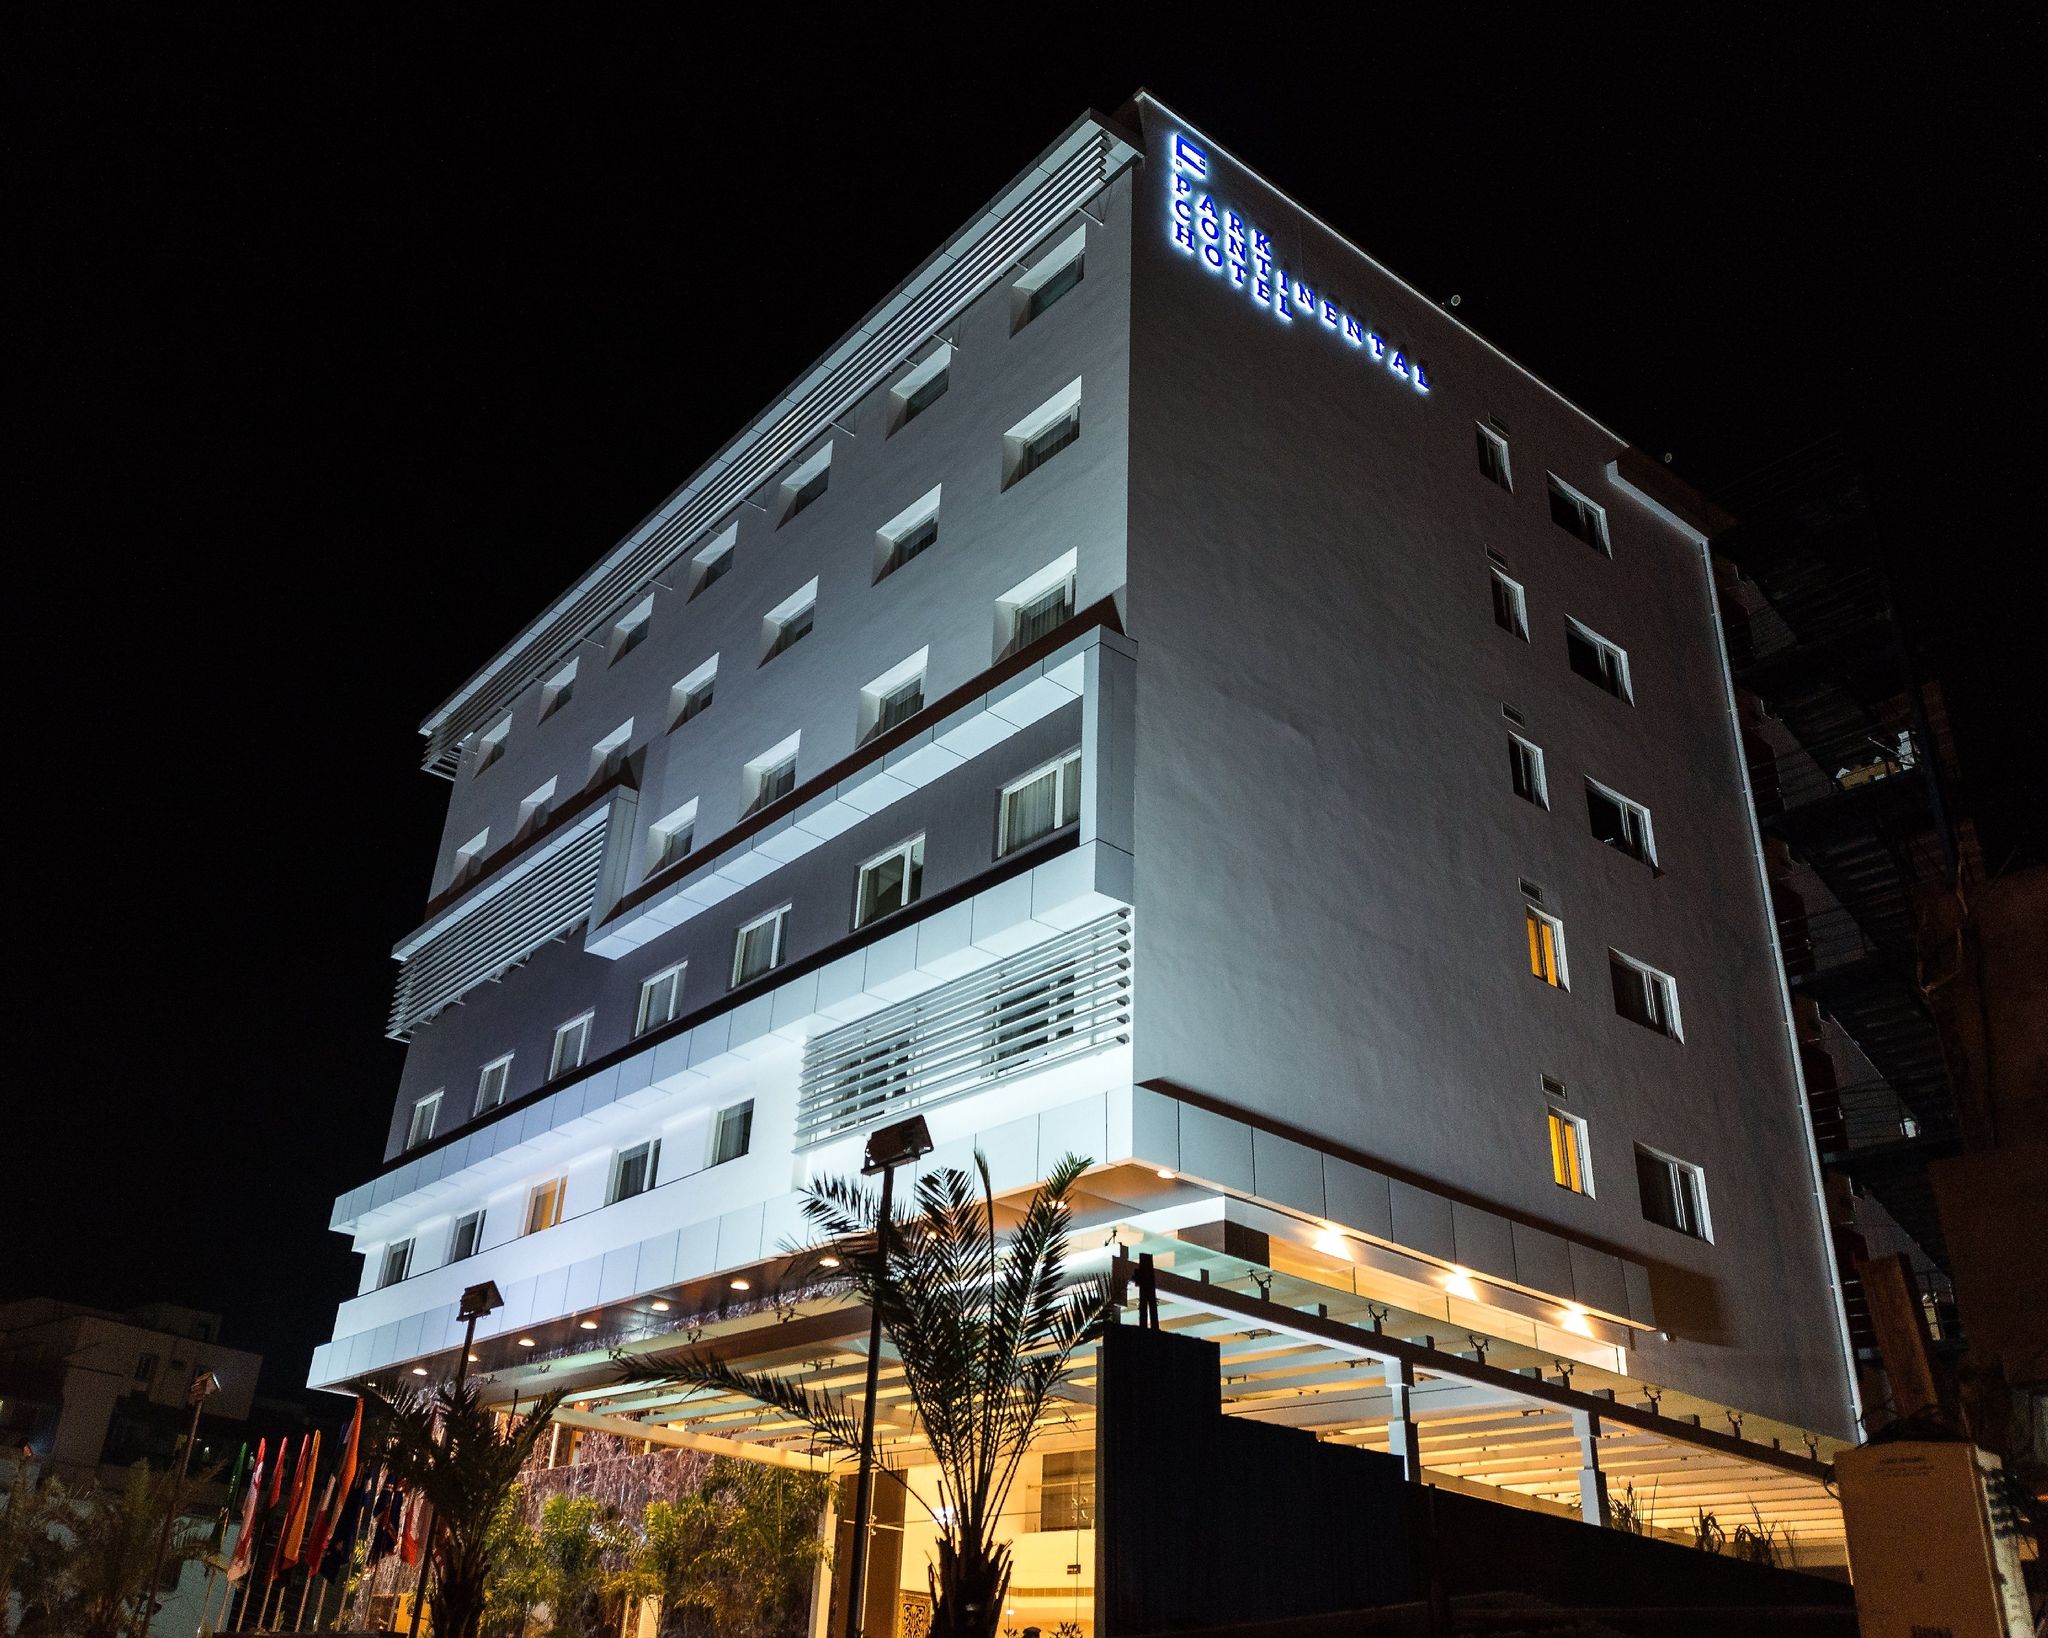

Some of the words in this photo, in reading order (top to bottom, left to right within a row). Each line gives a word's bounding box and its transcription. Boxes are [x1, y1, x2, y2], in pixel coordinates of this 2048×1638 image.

[1175, 172, 1272, 258] PARK
[1174, 199, 1430, 391] CONTINENTAL
[1175, 221, 1293, 321] HOTEL
